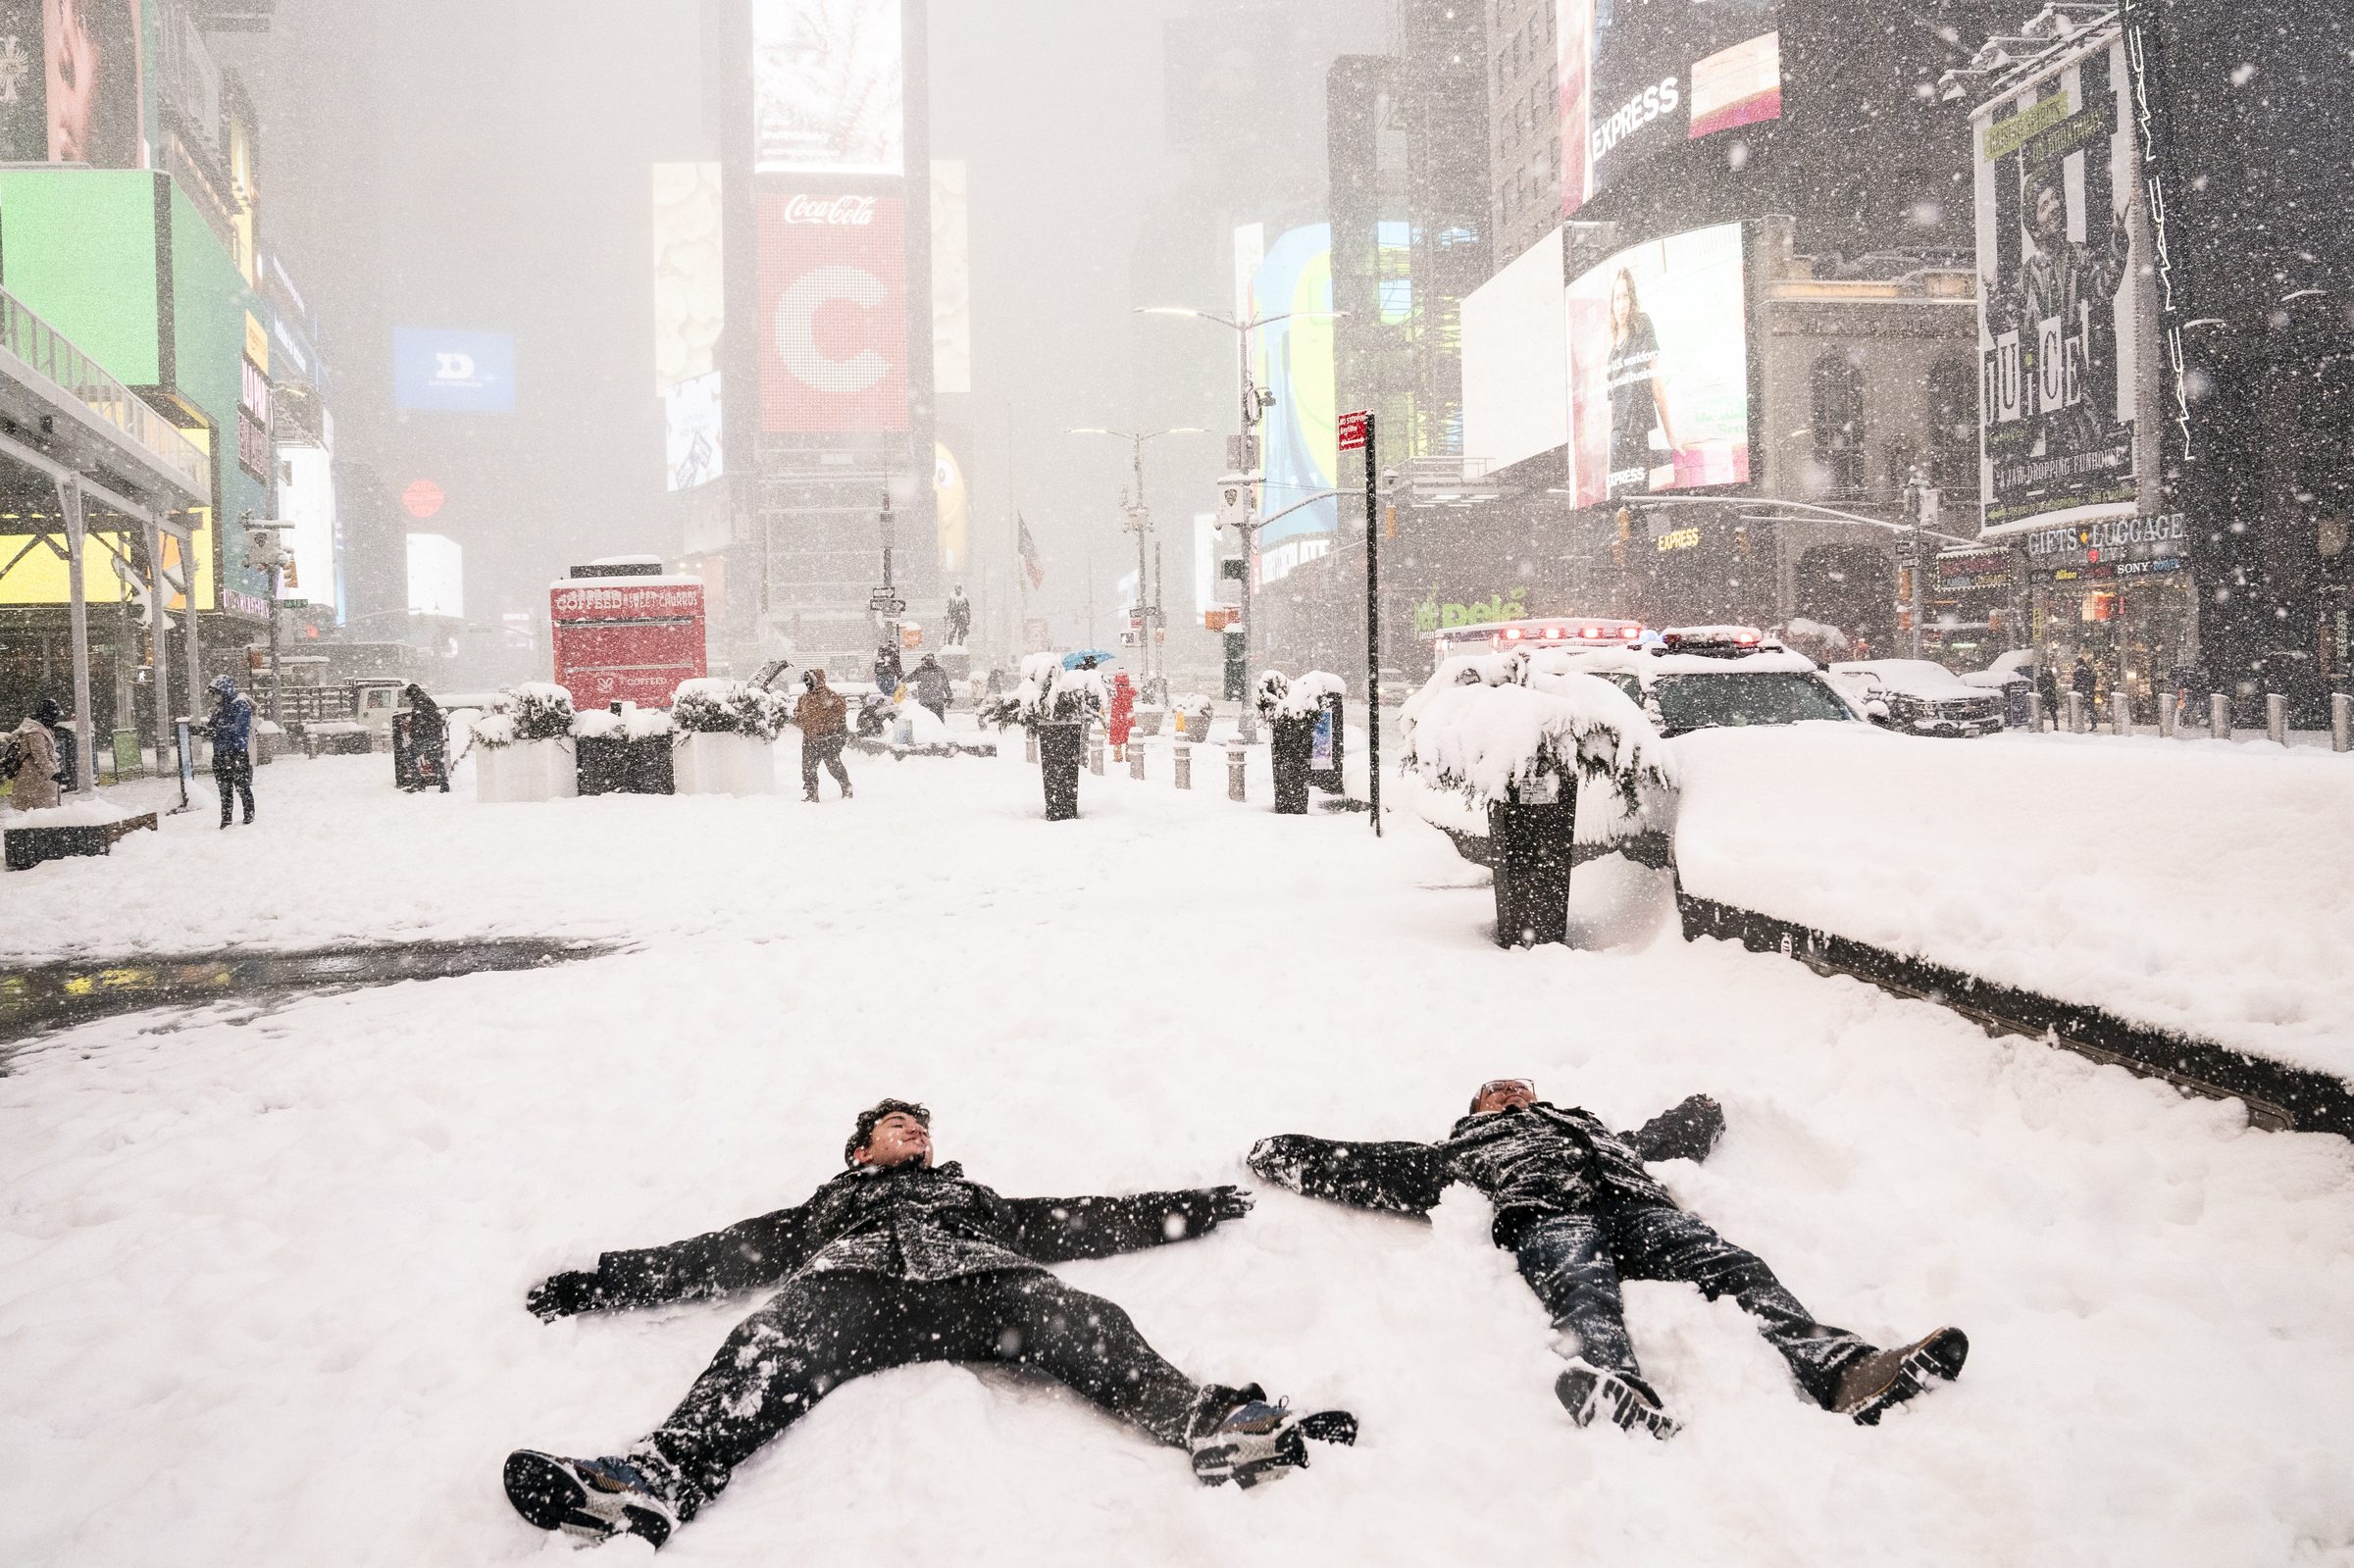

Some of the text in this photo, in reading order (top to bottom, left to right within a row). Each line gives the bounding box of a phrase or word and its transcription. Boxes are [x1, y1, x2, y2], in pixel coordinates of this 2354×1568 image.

[1593, 76, 1678, 163] EXPRESS
[785, 194, 878, 226] Coca-Cola
[775, 266, 891, 392] C
[1658, 527, 1700, 552] EXPRESS
[2028, 513, 2185, 555] GIFTS LUGGAGE
[2055, 569, 2077, 581] Nikon
[2117, 561, 2150, 575] SONY
[556, 589, 623, 610] COFFEED
